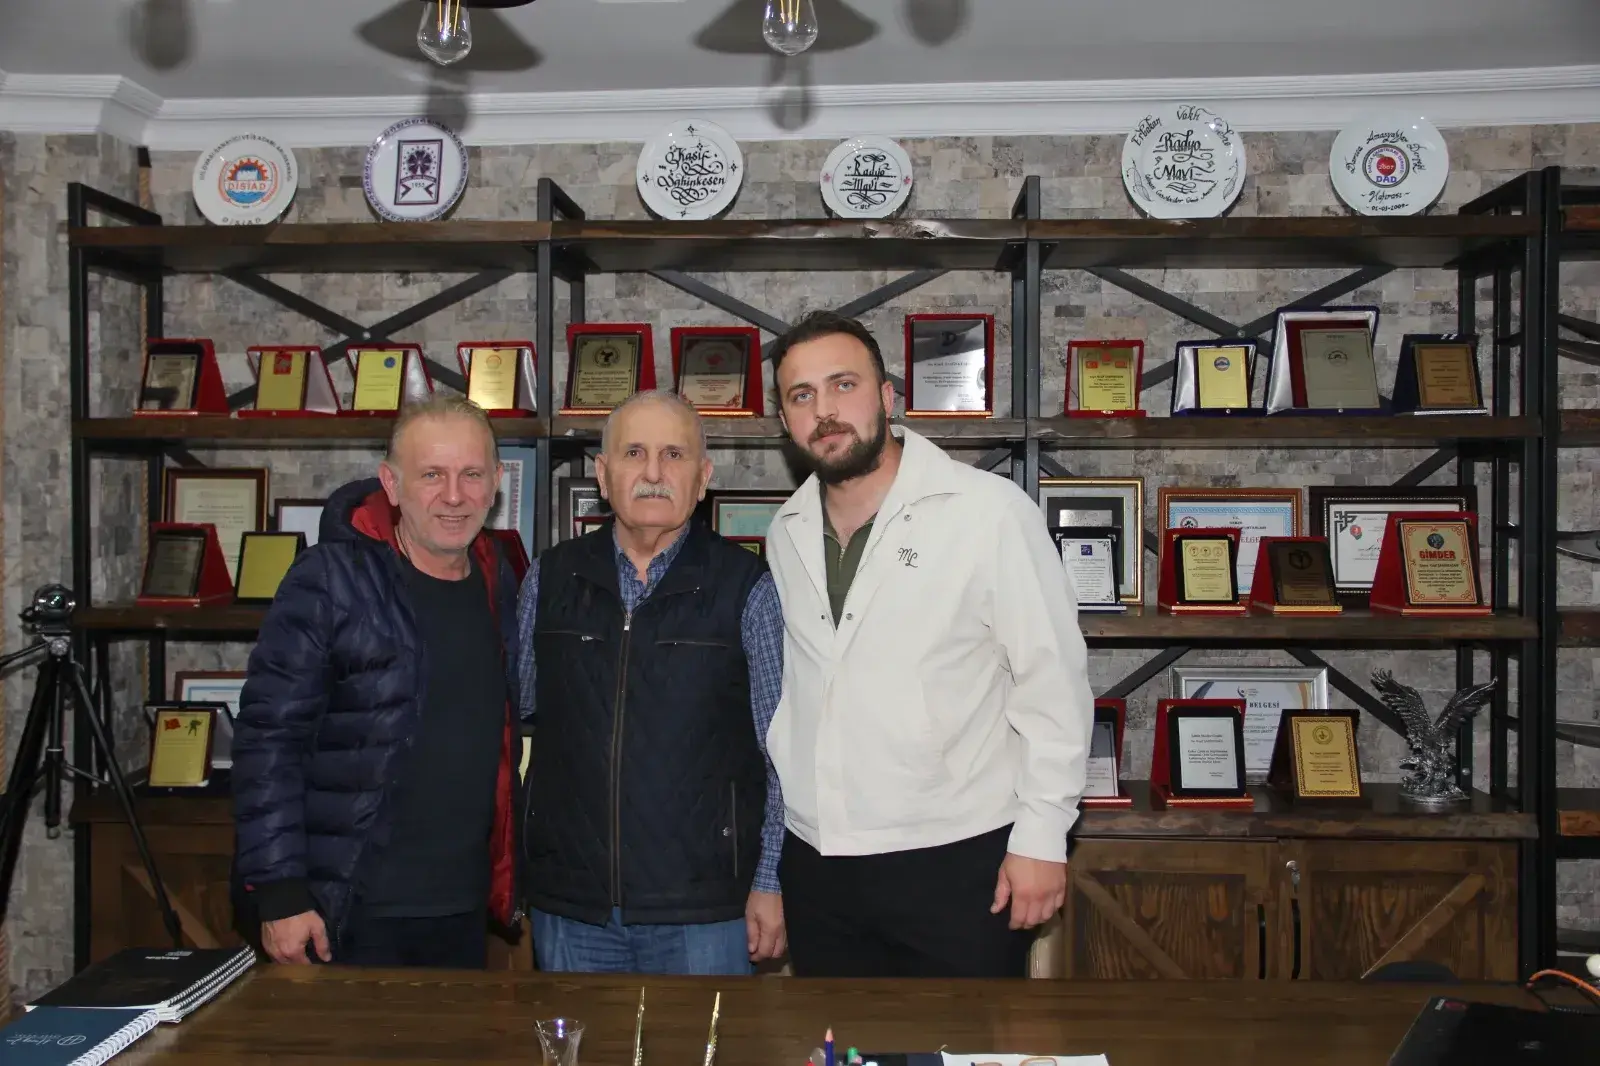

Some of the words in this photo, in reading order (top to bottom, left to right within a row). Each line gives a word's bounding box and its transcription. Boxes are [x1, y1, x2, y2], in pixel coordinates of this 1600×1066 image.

[1131, 115, 1162, 146] Erbakan
[1159, 130, 1201, 162] Radyo
[1154, 162, 1194, 180] Mavi
[1376, 175, 1397, 183] DAD
[1419, 549, 1456, 559] GİMDER
[1250, 701, 1280, 709] BELGESİ
